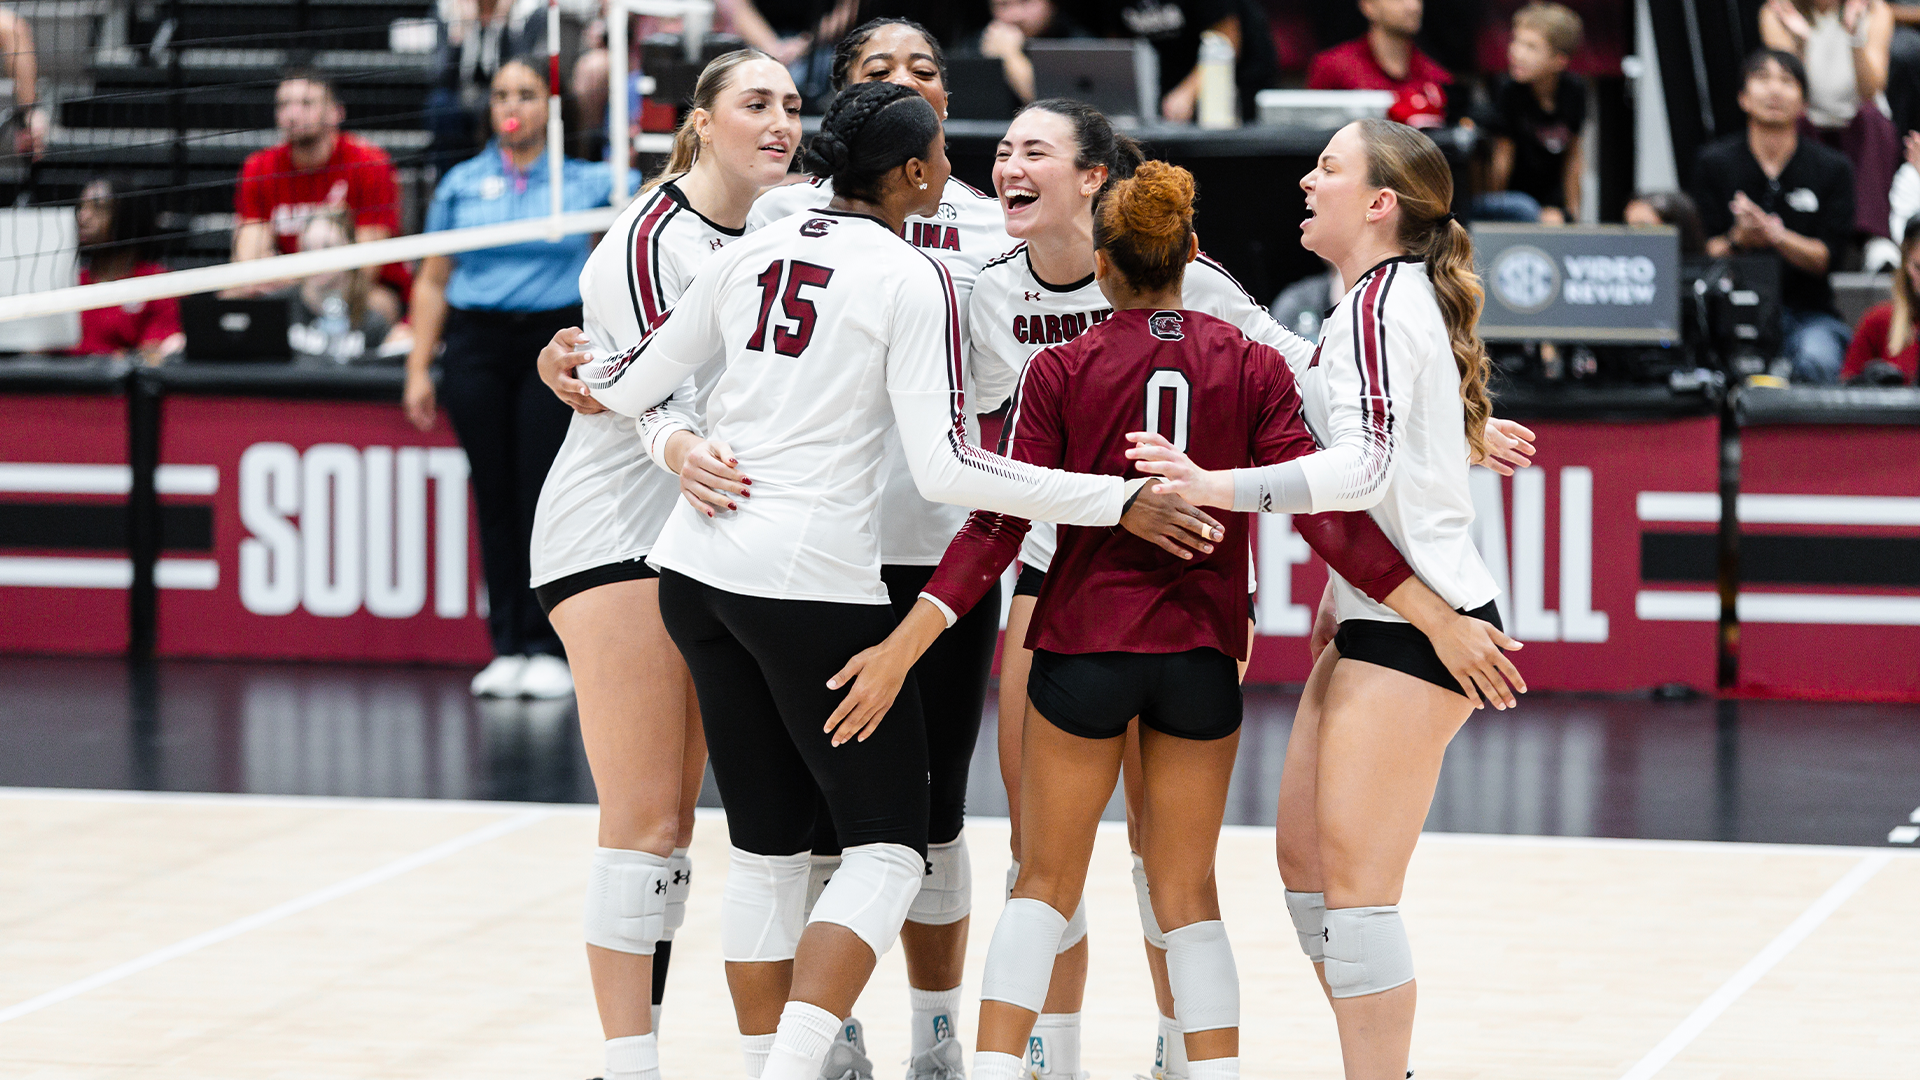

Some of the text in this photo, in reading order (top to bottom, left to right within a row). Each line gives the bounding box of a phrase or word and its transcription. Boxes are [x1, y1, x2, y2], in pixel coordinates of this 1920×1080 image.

[746, 259, 835, 358] 15
[1562, 254, 1657, 283] VIDEO
[1562, 280, 1657, 306] REVIEW
[1143, 367, 1193, 453] 0
[238, 441, 490, 619] SOUT
